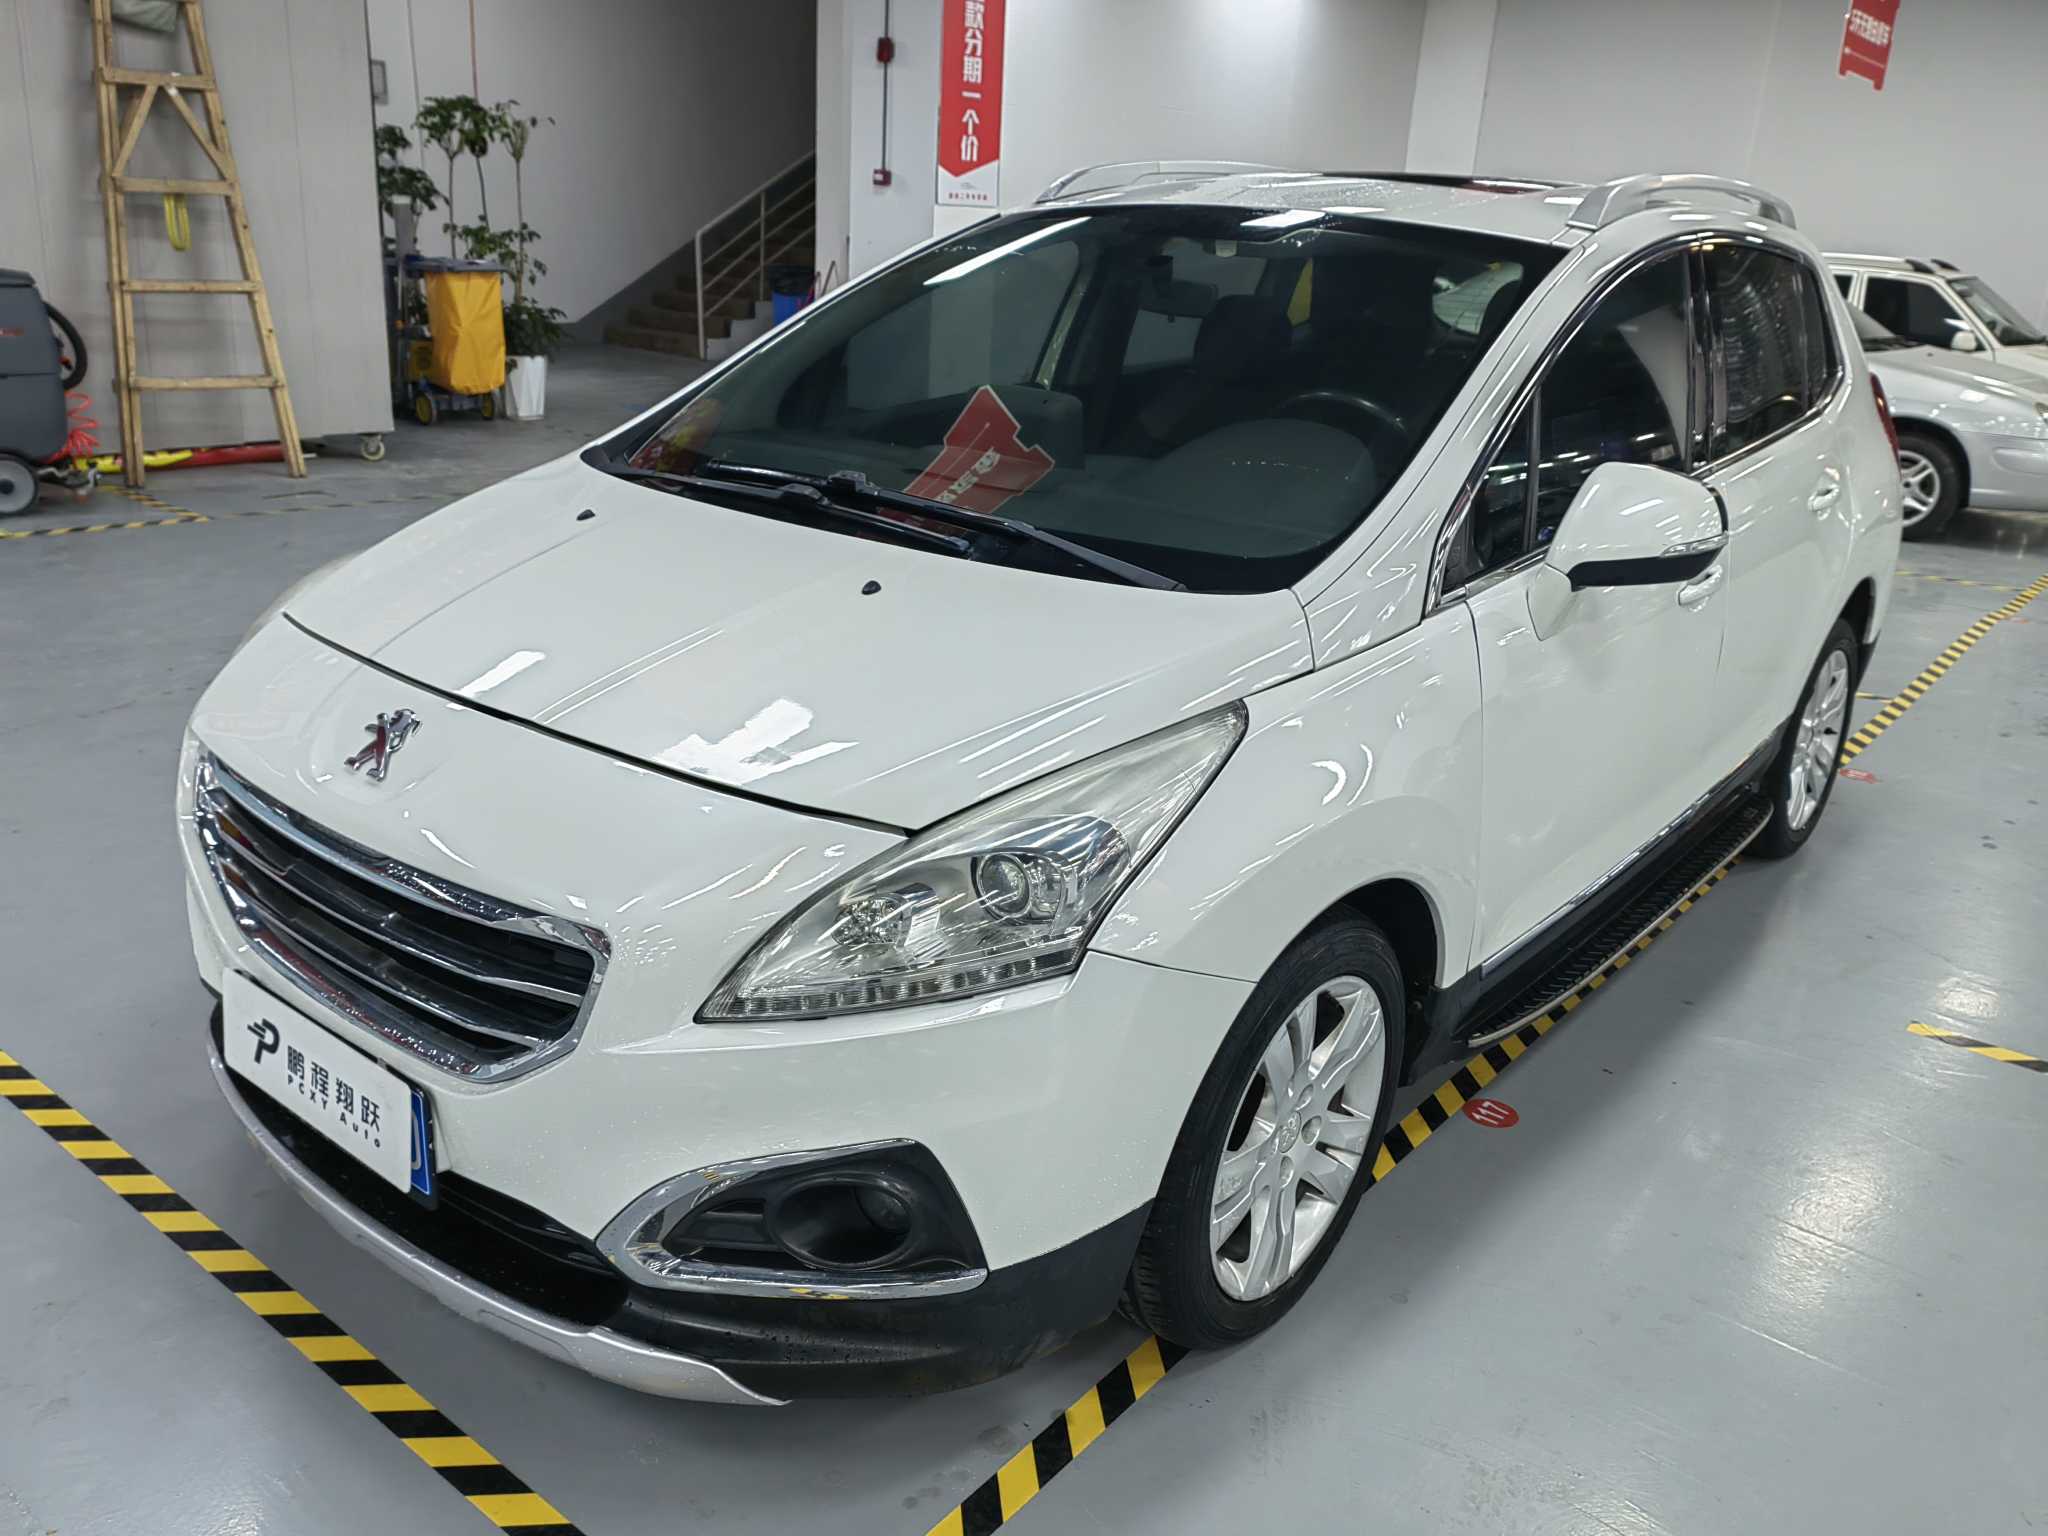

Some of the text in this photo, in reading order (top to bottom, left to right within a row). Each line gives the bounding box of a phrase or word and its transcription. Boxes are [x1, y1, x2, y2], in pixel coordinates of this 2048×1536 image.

[961, 0, 985, 162] 款分期一个价
[287, 1045, 381, 1132] 鹏程翔跃
[287, 1074, 328, 1110] PCXY
[339, 1113, 381, 1148] Auto
[1471, 1101, 1509, 1125] 117
